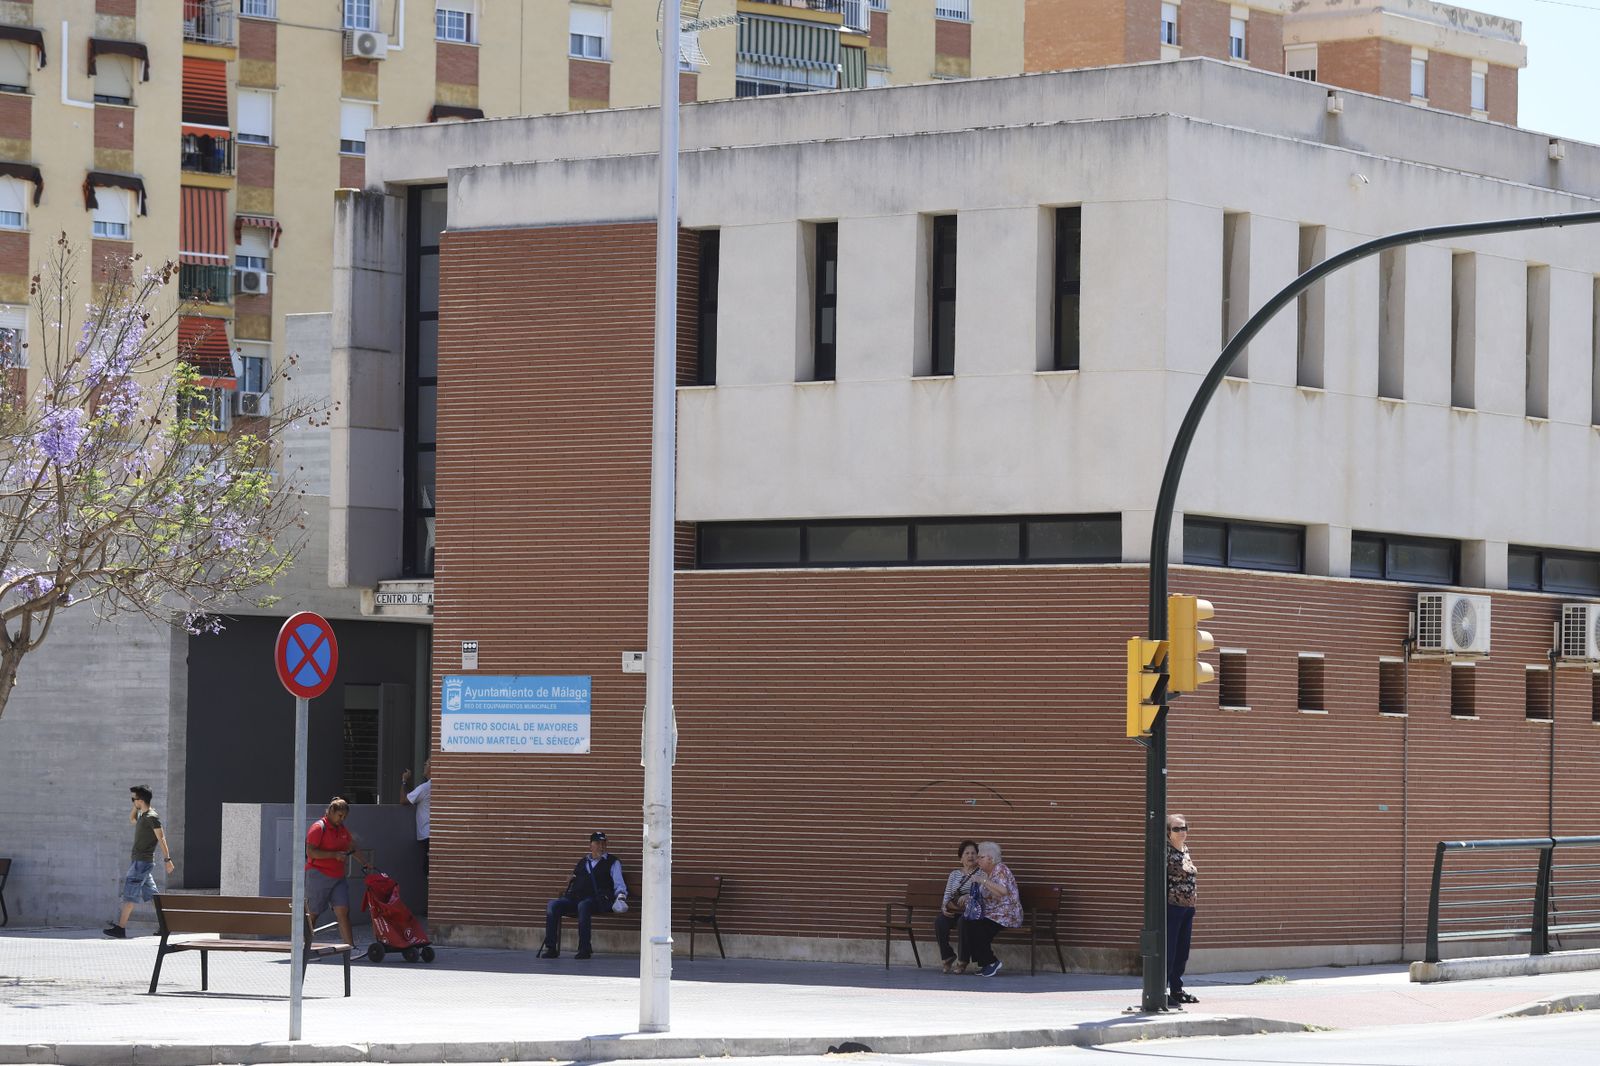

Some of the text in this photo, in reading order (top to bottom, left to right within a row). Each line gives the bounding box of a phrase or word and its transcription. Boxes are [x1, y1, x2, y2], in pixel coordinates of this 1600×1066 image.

[376, 594, 407, 603] CENTRO
[412, 594, 422, 603] DE
[464, 686, 588, 700] Ayuntamiento de Málaga
[453, 722, 578, 731] CENTRO SOCIAL DE MAYORES
[447, 734, 585, 746] ANTONIO MARTELO "EL SÉNECA"
